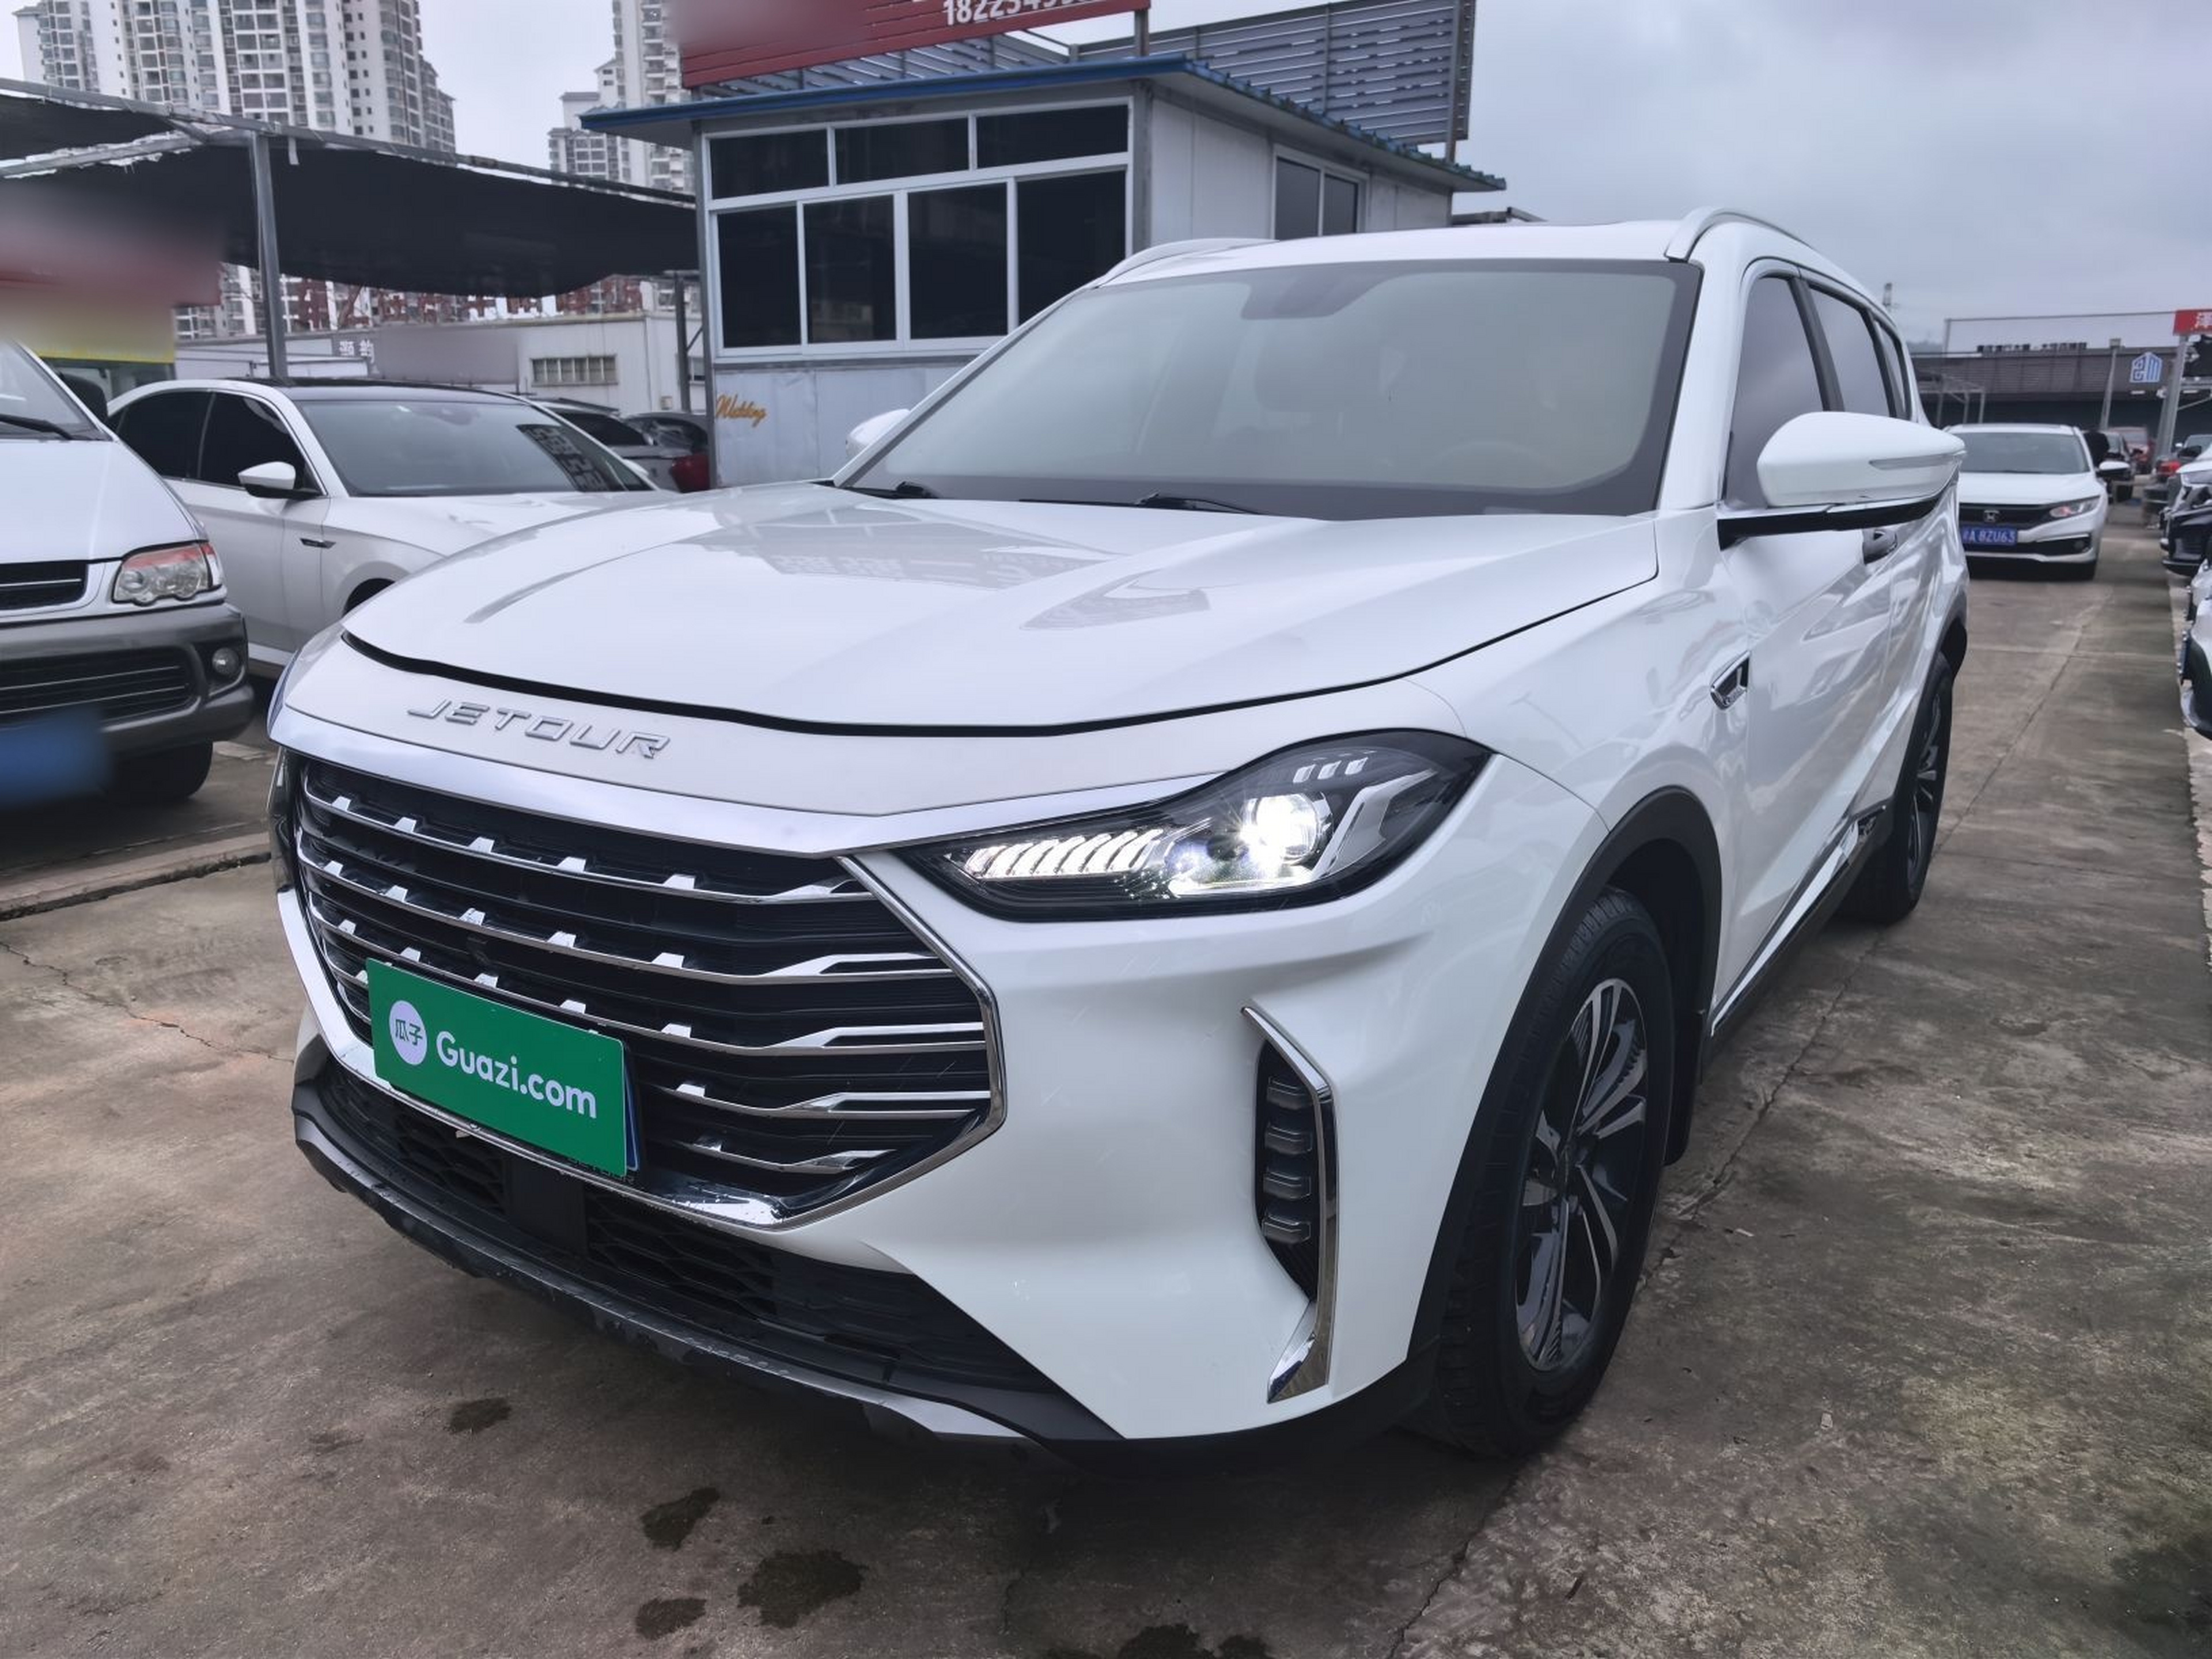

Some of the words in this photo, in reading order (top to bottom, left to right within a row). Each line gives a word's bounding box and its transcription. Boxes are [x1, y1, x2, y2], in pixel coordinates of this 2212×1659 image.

[407, 699, 671, 759] JETOUR
[395, 1018, 423, 1046] 瓜子
[436, 1031, 597, 1119] Guazi.com
